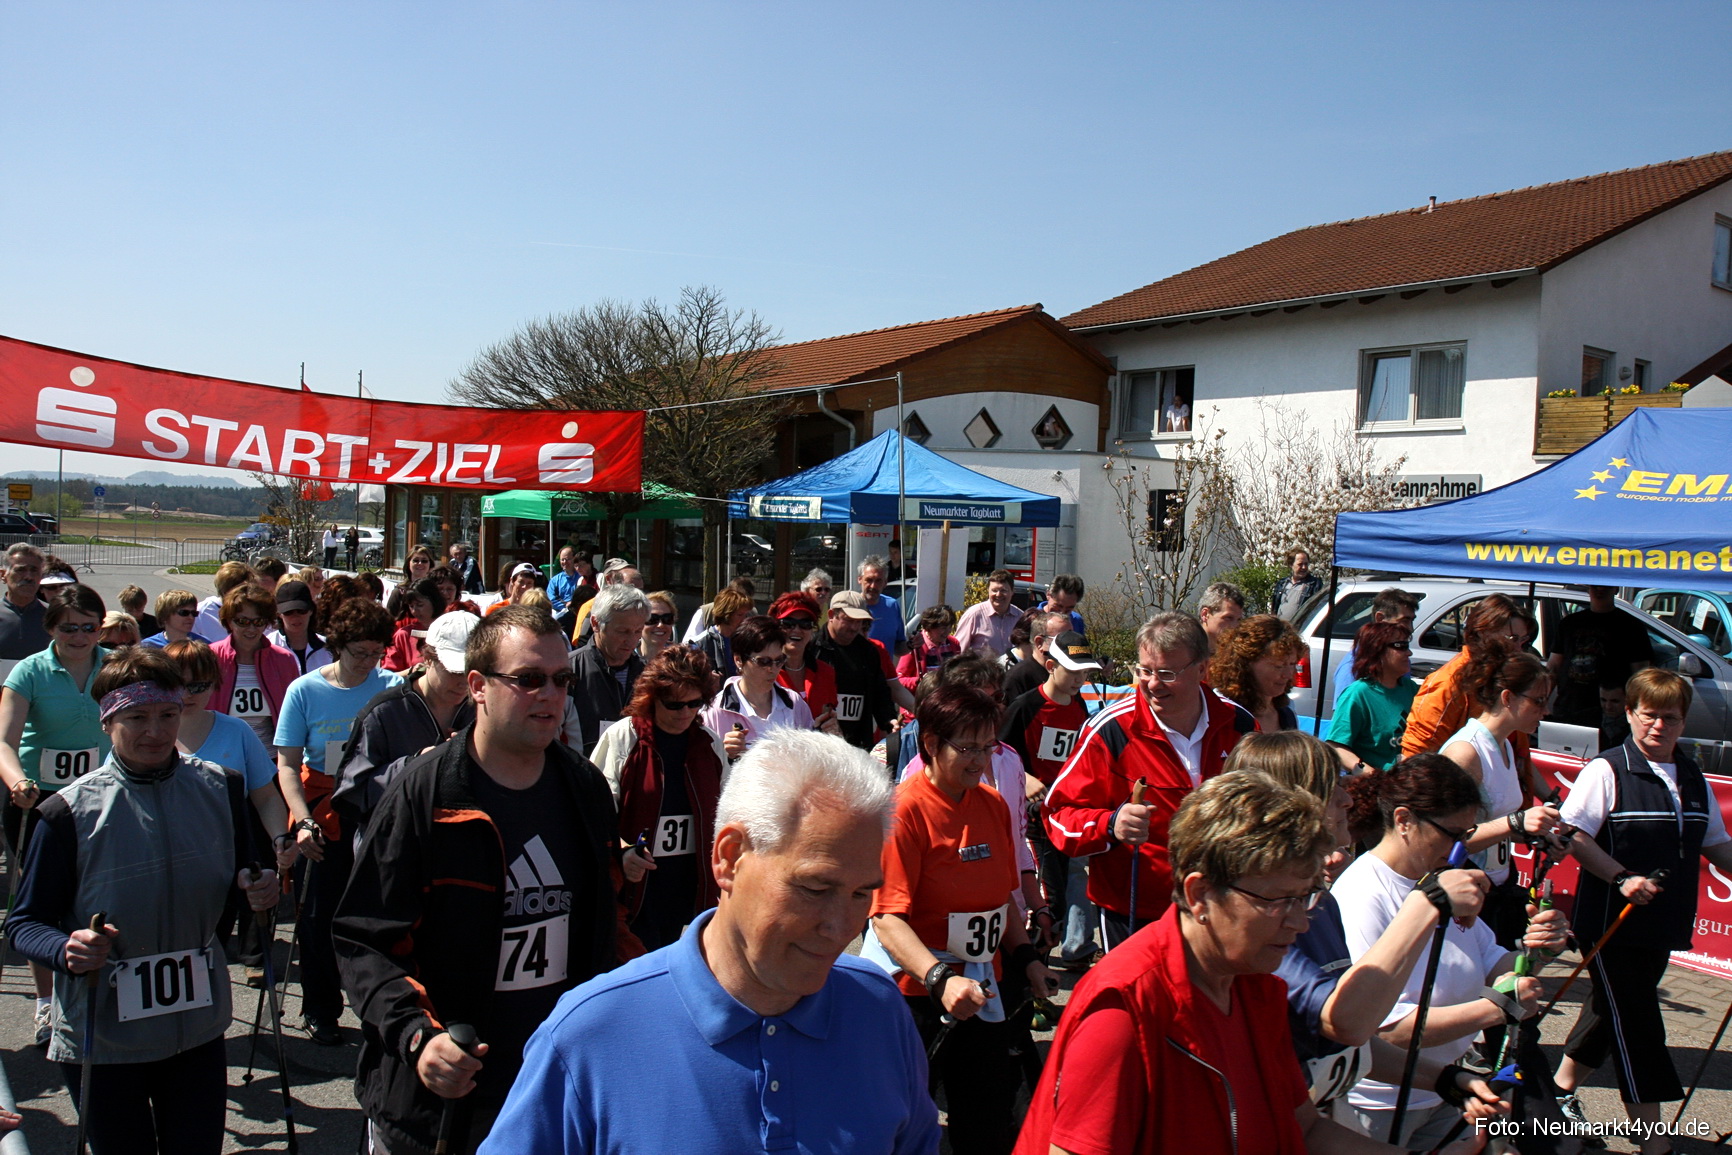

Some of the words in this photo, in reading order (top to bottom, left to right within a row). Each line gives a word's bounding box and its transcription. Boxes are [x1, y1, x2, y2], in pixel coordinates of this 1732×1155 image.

[1621, 470, 1732, 495] EM
[557, 500, 589, 513] AOK
[1615, 492, 1672, 503] european
[923, 505, 969, 517] Neumarkter
[969, 506, 1002, 519] Tagblatt
[235, 688, 263, 713] 30
[841, 696, 862, 718] 107
[1052, 730, 1075, 758] 51
[55, 751, 90, 780] 90
[662, 818, 689, 853] 31
[503, 885, 573, 917] didas
[965, 912, 1001, 957] 36
[502, 925, 549, 982] 74
[134, 954, 195, 1010] 101
